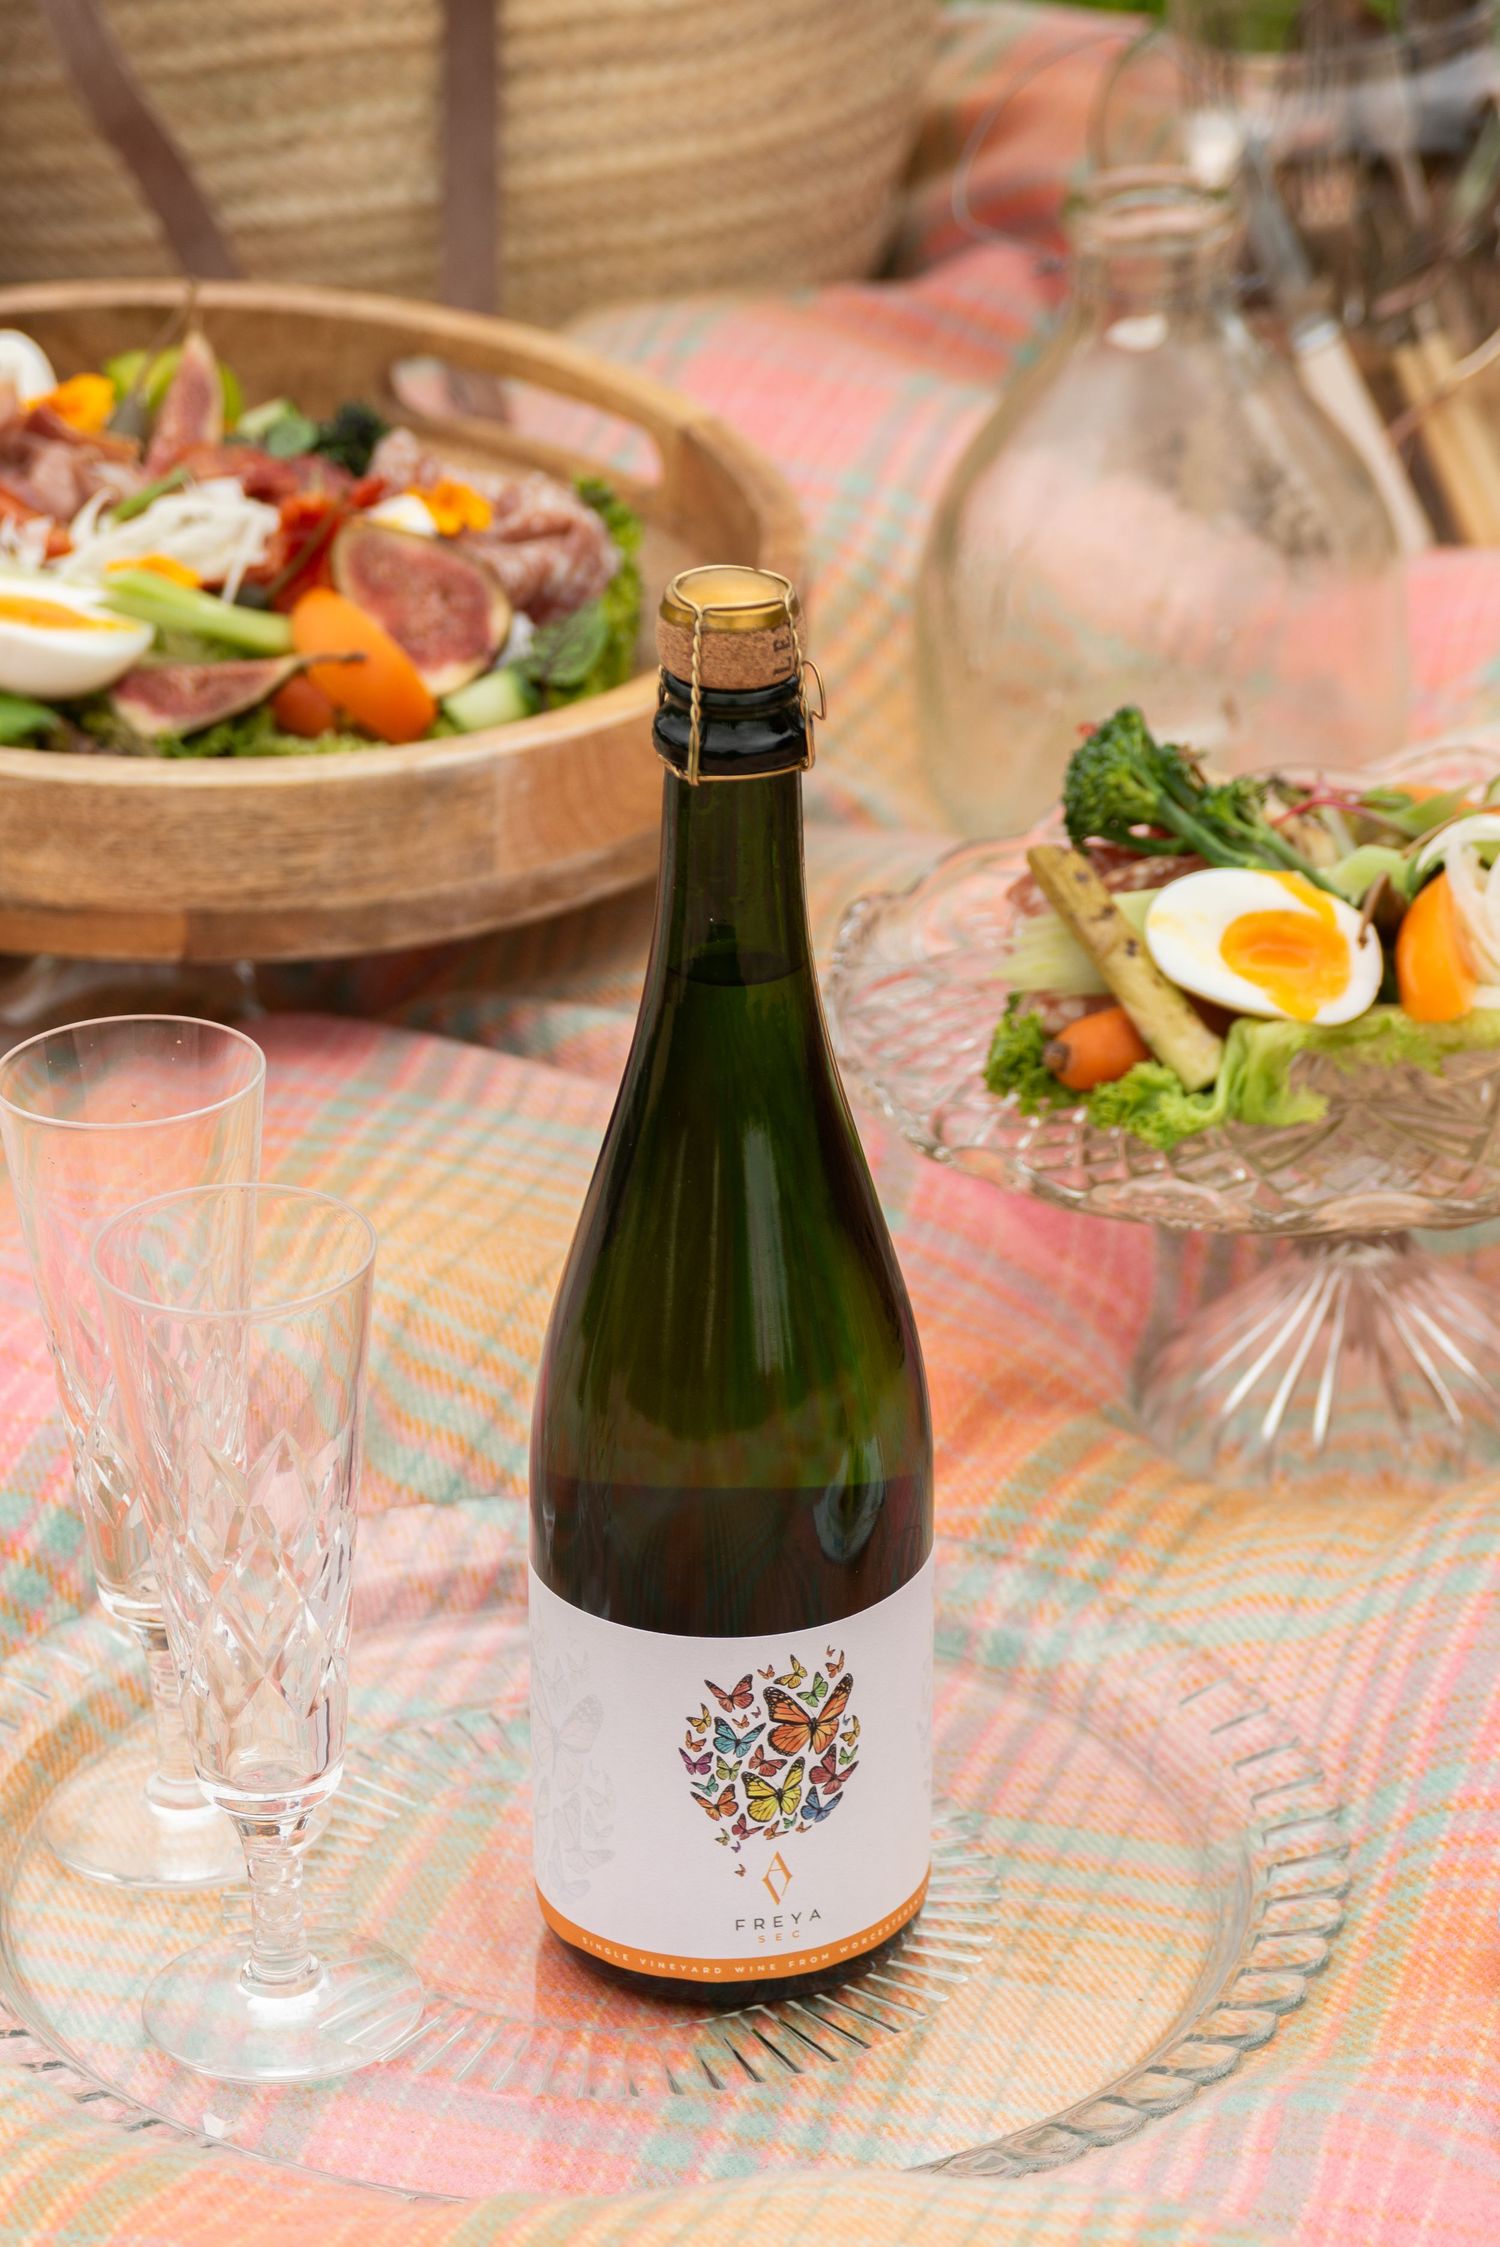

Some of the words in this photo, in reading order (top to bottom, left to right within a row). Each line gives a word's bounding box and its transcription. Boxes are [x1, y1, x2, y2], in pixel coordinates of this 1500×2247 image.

[735, 1908, 822, 1932] FREYA
[581, 1936, 630, 1962] SINGLE
[639, 1957, 722, 1975] VINEYARD
[734, 1962, 777, 1974] WINE
[788, 1952, 830, 1969] FROM
